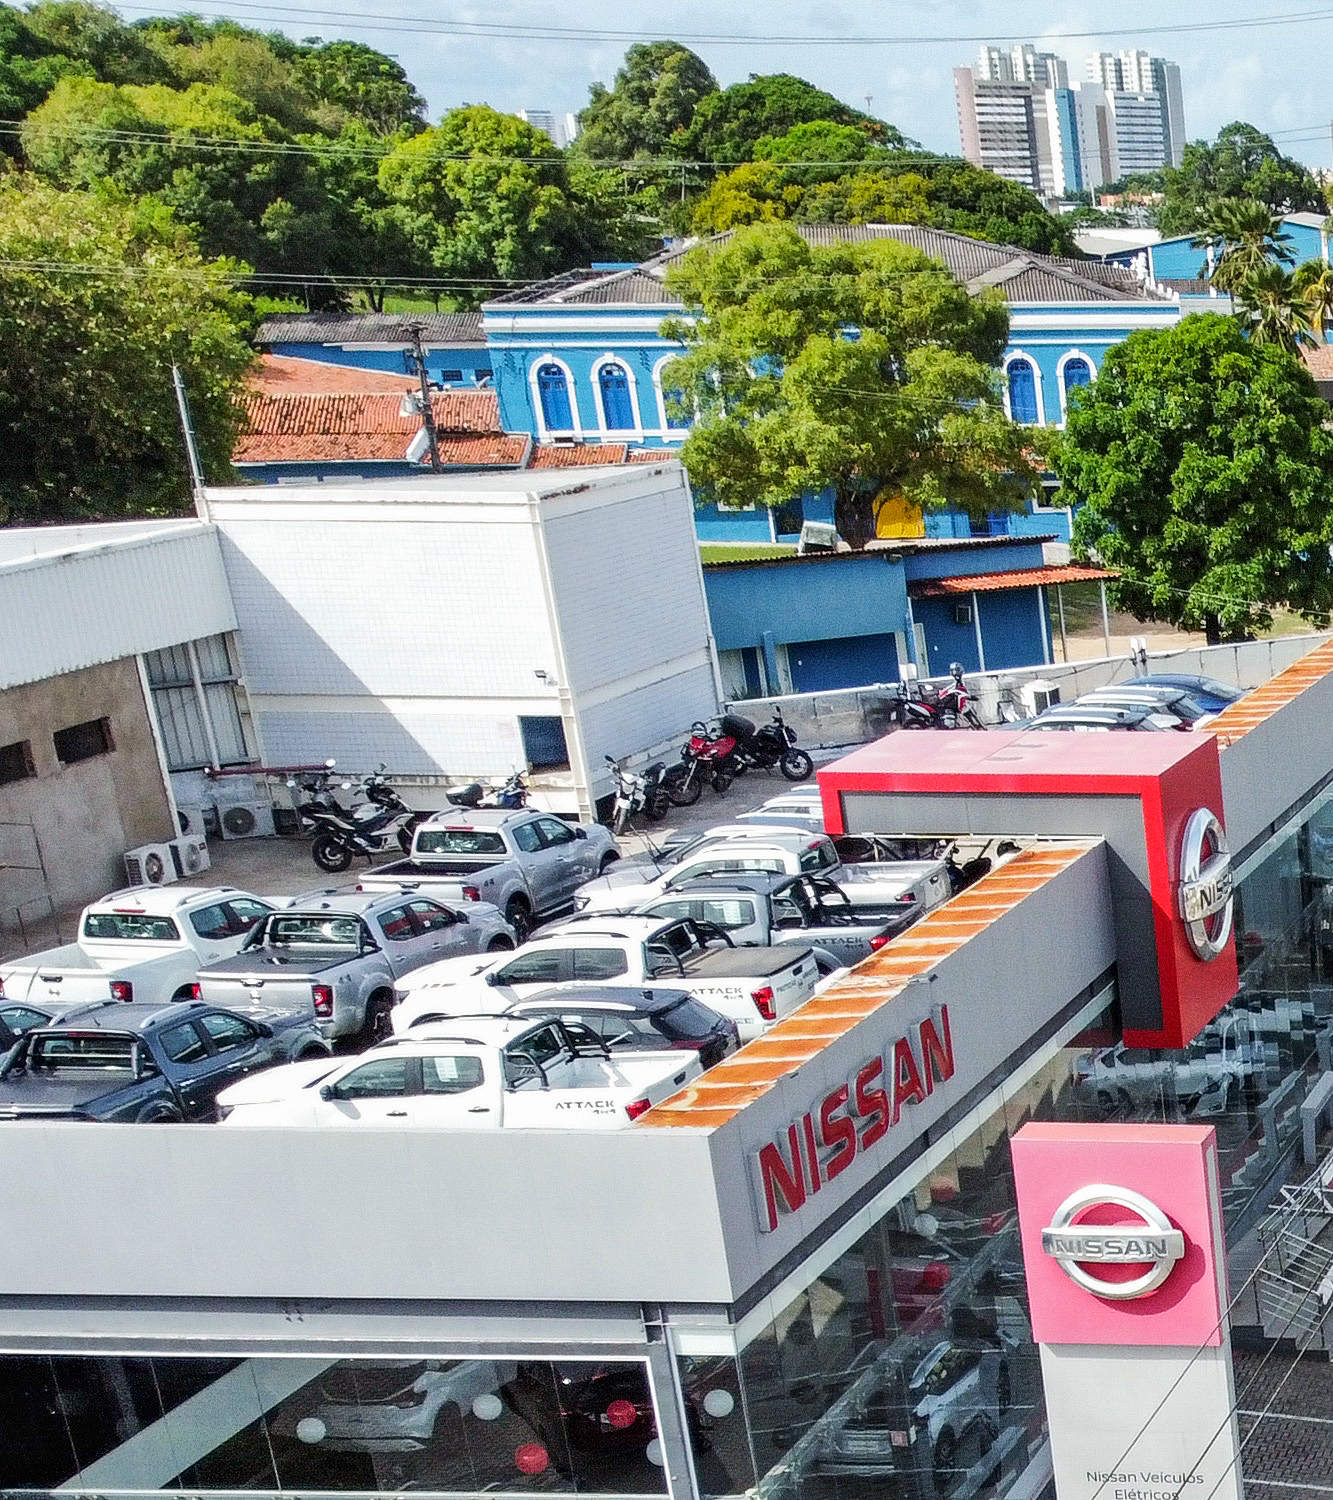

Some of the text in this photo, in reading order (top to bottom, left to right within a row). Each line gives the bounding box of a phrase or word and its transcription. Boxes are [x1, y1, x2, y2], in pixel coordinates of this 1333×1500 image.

[814, 937, 863, 945] ATTACK
[691, 987, 743, 996] ATTACK
[554, 1101, 614, 1110] ATTACK
[755, 1004, 955, 1233] NISSAN
[1053, 1238, 1169, 1258] NISSAN
[1086, 1471, 1205, 1484] Nissan Veículos
[1115, 1488, 1180, 1500] Elétricos
